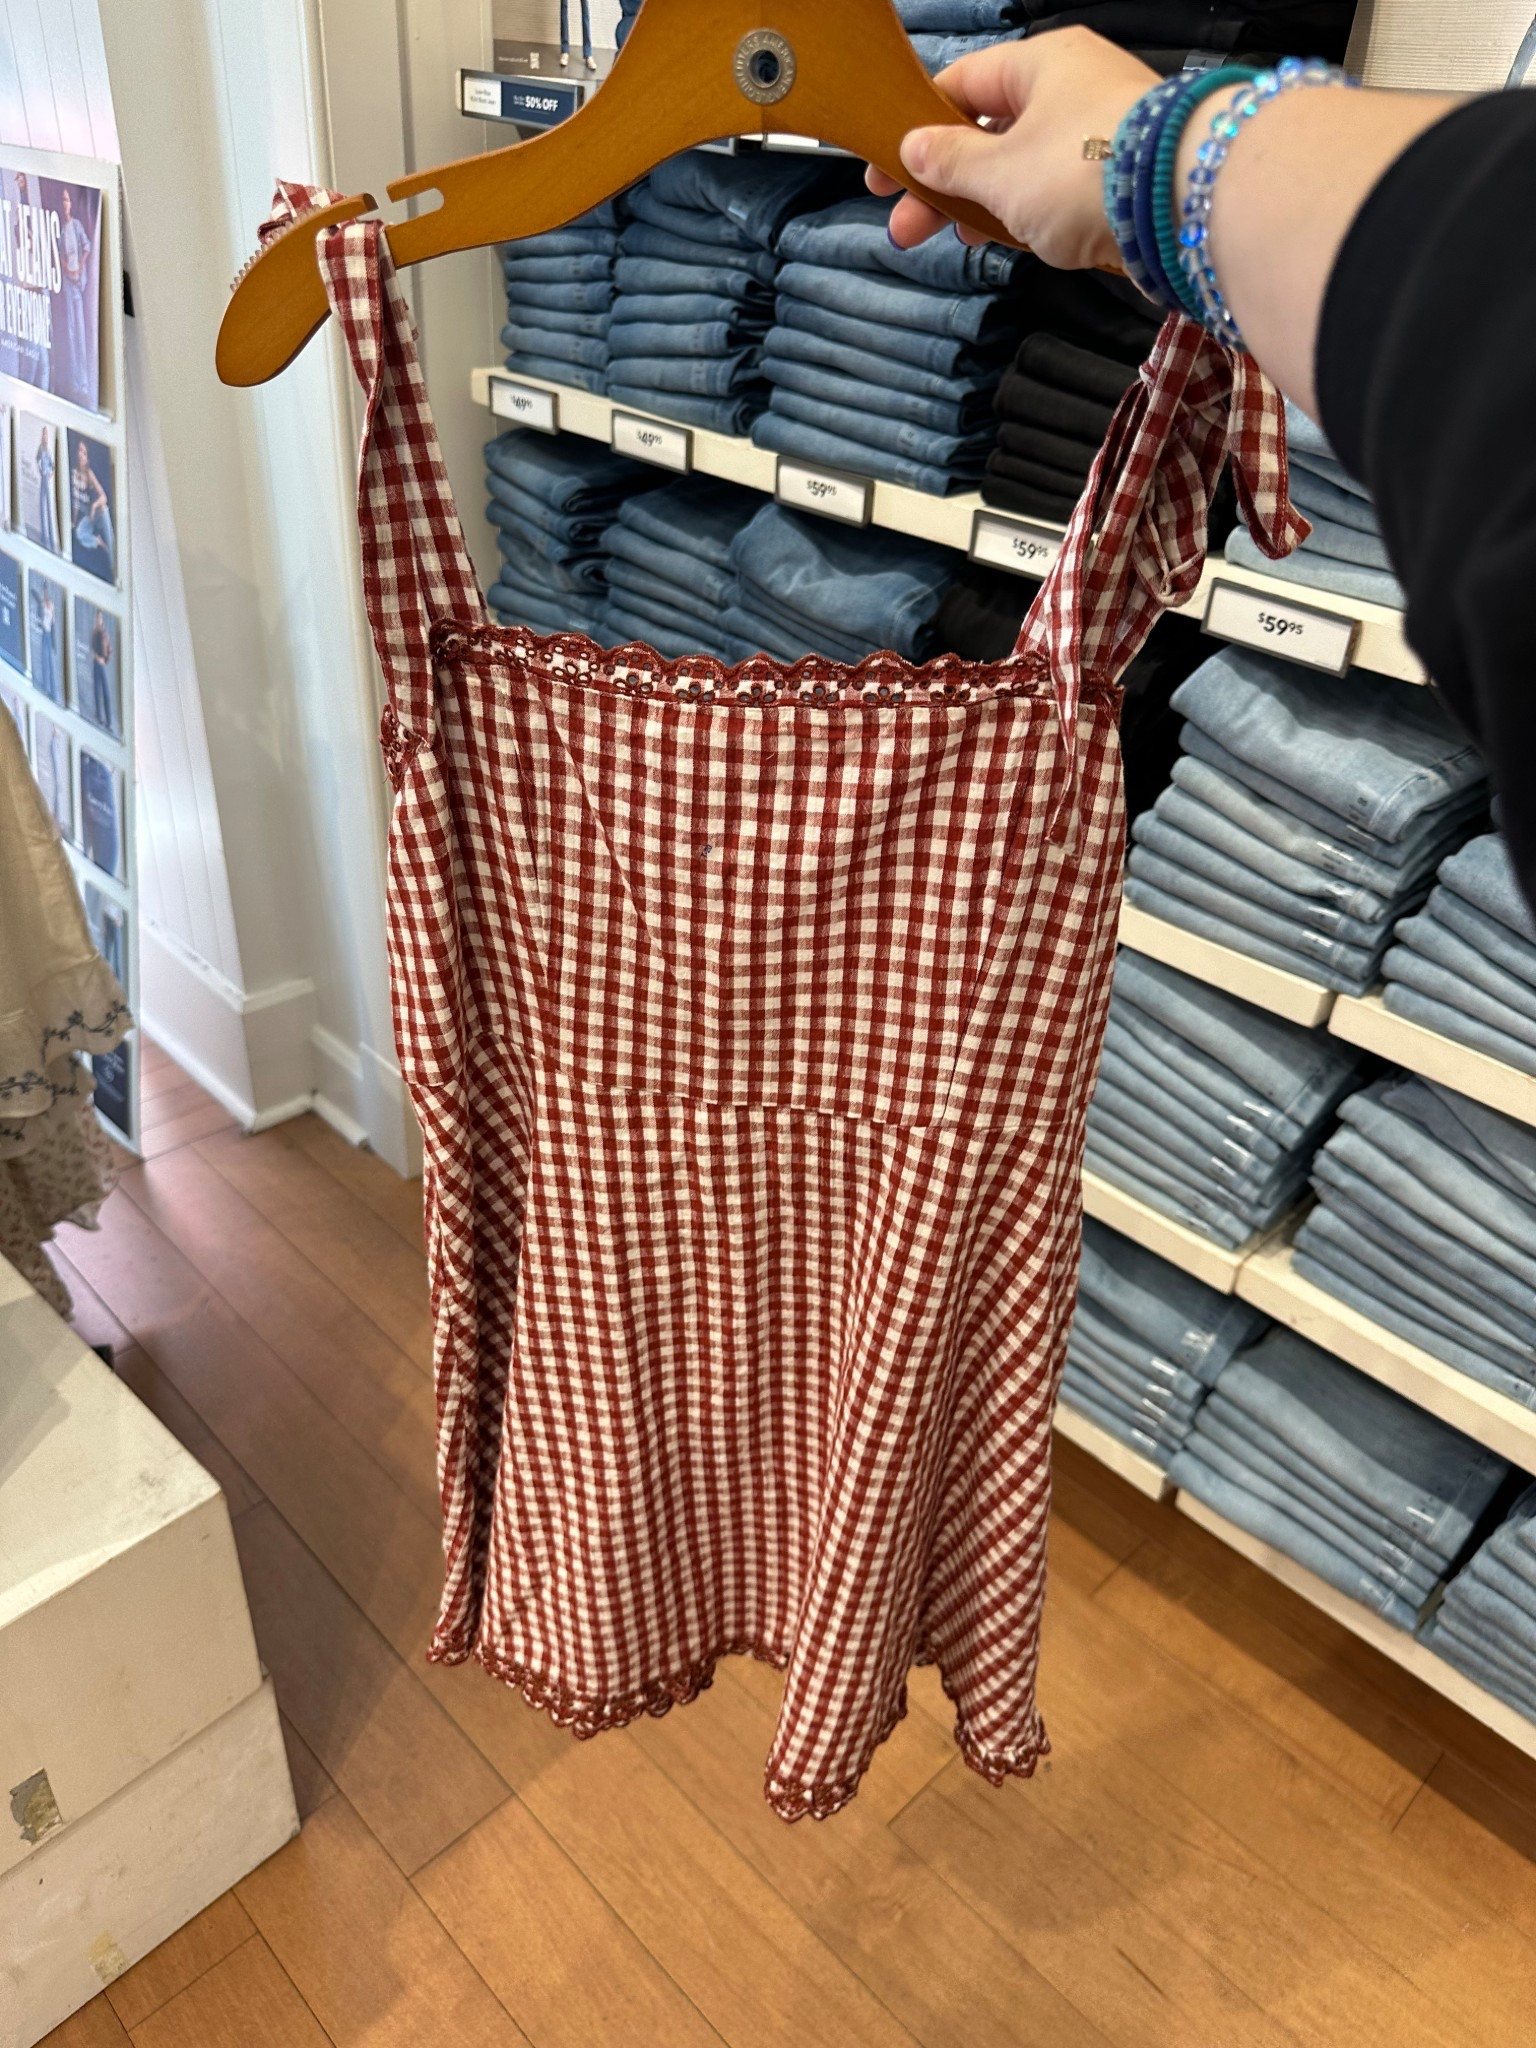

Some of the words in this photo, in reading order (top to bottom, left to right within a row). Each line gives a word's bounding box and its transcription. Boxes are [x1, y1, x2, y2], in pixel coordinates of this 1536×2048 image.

[525, 95, 542, 110] 50%
[543, 98, 559, 112] OFF
[16, 203, 62, 294] JEANS
[6, 283, 52, 349] EVERYONE
